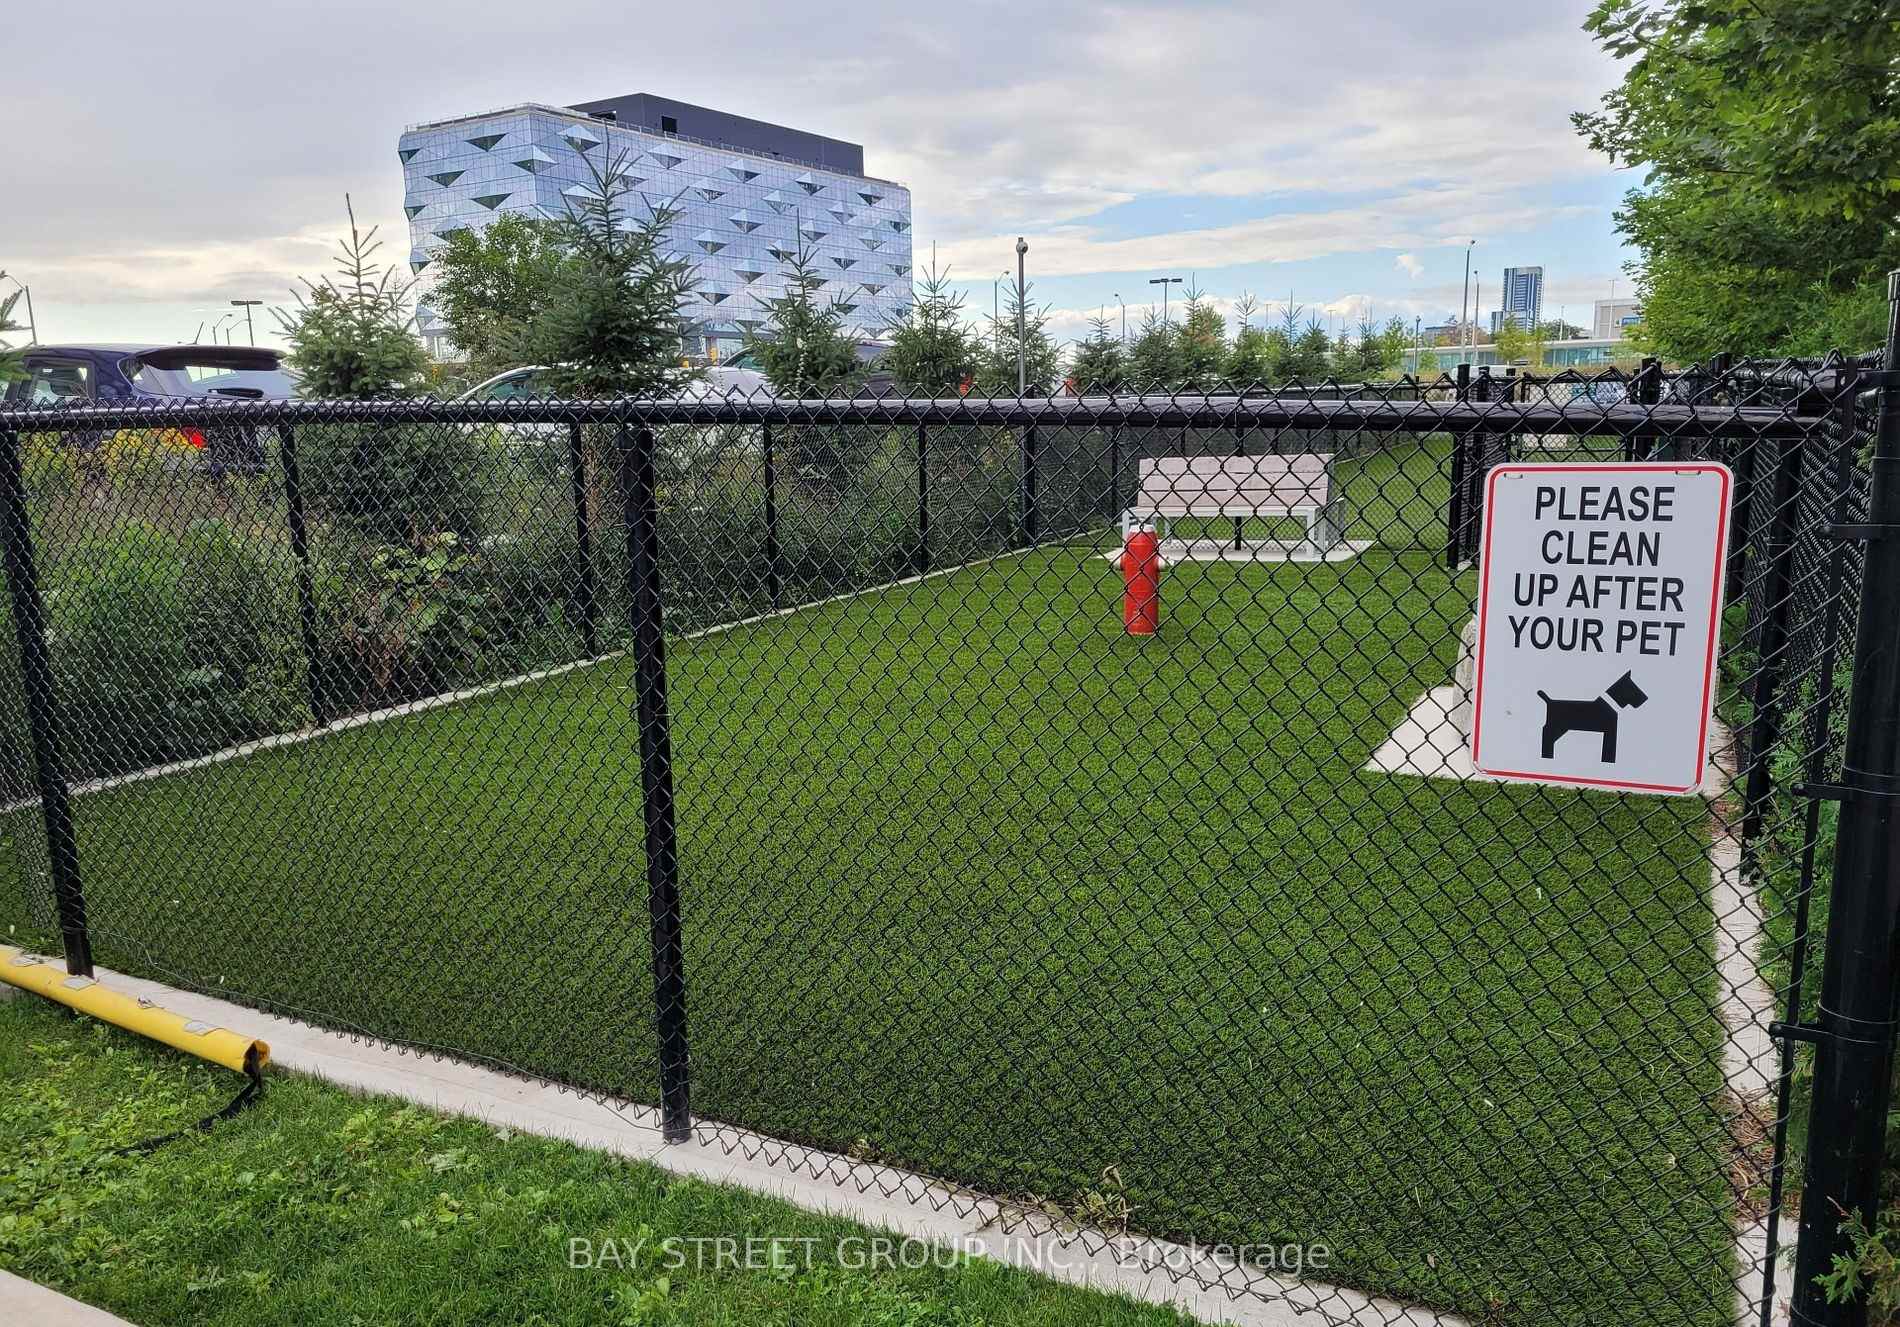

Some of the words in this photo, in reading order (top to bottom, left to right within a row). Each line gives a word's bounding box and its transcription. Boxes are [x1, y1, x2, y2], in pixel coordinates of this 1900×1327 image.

[1535, 486, 1676, 522] PLEASE
[1541, 530, 1661, 567] CLEAN
[1514, 573, 1559, 607] UP
[1565, 575, 1684, 613] AFTER
[1508, 616, 1604, 653] YOUR
[1615, 620, 1686, 657] PET
